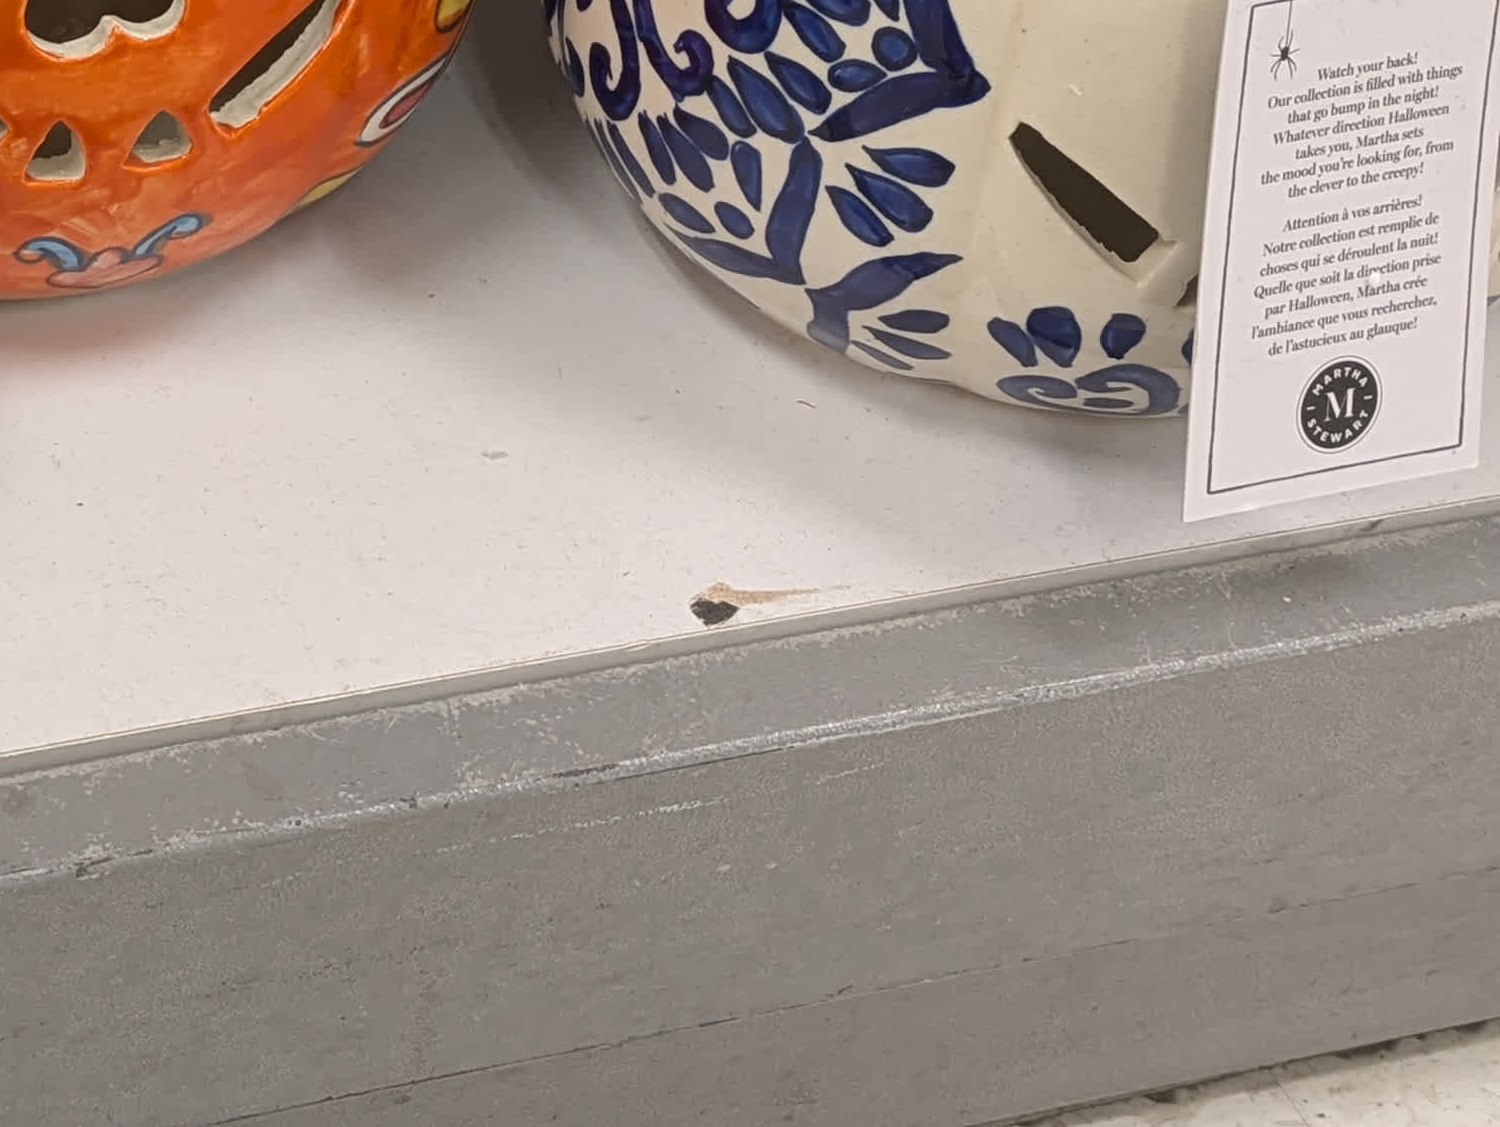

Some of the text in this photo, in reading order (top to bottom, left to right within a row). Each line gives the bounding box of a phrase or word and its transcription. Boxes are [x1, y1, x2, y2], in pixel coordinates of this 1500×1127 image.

[1317, 52, 1418, 81] Watch your back!
[1268, 65, 1463, 109] Our collection is filled with things
[1287, 86, 1439, 124] that go bump in the night!
[1273, 106, 1449, 145] Whatever direction Halloween
[1295, 144, 1326, 160] takes
[1356, 130, 1399, 149] Martha
[1402, 127, 1424, 138] sets
[1261, 169, 1280, 185] the
[1283, 163, 1316, 181] mood
[1357, 149, 1400, 167] looking
[1403, 146, 1422, 161] for,
[1425, 140, 1454, 156] from
[1288, 162, 1424, 198] the clever to the creepy!
[1283, 194, 1422, 233] Attention à vos arrières!
[1263, 212, 1439, 257] Notre collection est remplie de
[1260, 232, 1438, 277] choses qui se déroulent la nuit!
[1254, 280, 1292, 300] Quelle
[1295, 276, 1316, 291] que
[1320, 270, 1341, 285] soit
[1344, 268, 1354, 281] la
[1412, 253, 1441, 270] prise
[1265, 276, 1428, 319] par Halloween, Martha crée
[1317, 313, 1339, 329] que
[1342, 307, 1368, 322] vous
[1371, 294, 1437, 316] recherchez,
[1268, 341, 1283, 356] de
[1350, 327, 1364, 341] au
[1366, 316, 1418, 341] glauque!
[1312, 367, 1368, 396] MARTHA
[1324, 388, 1356, 422] M
[1308, 410, 1368, 442] STEWART
